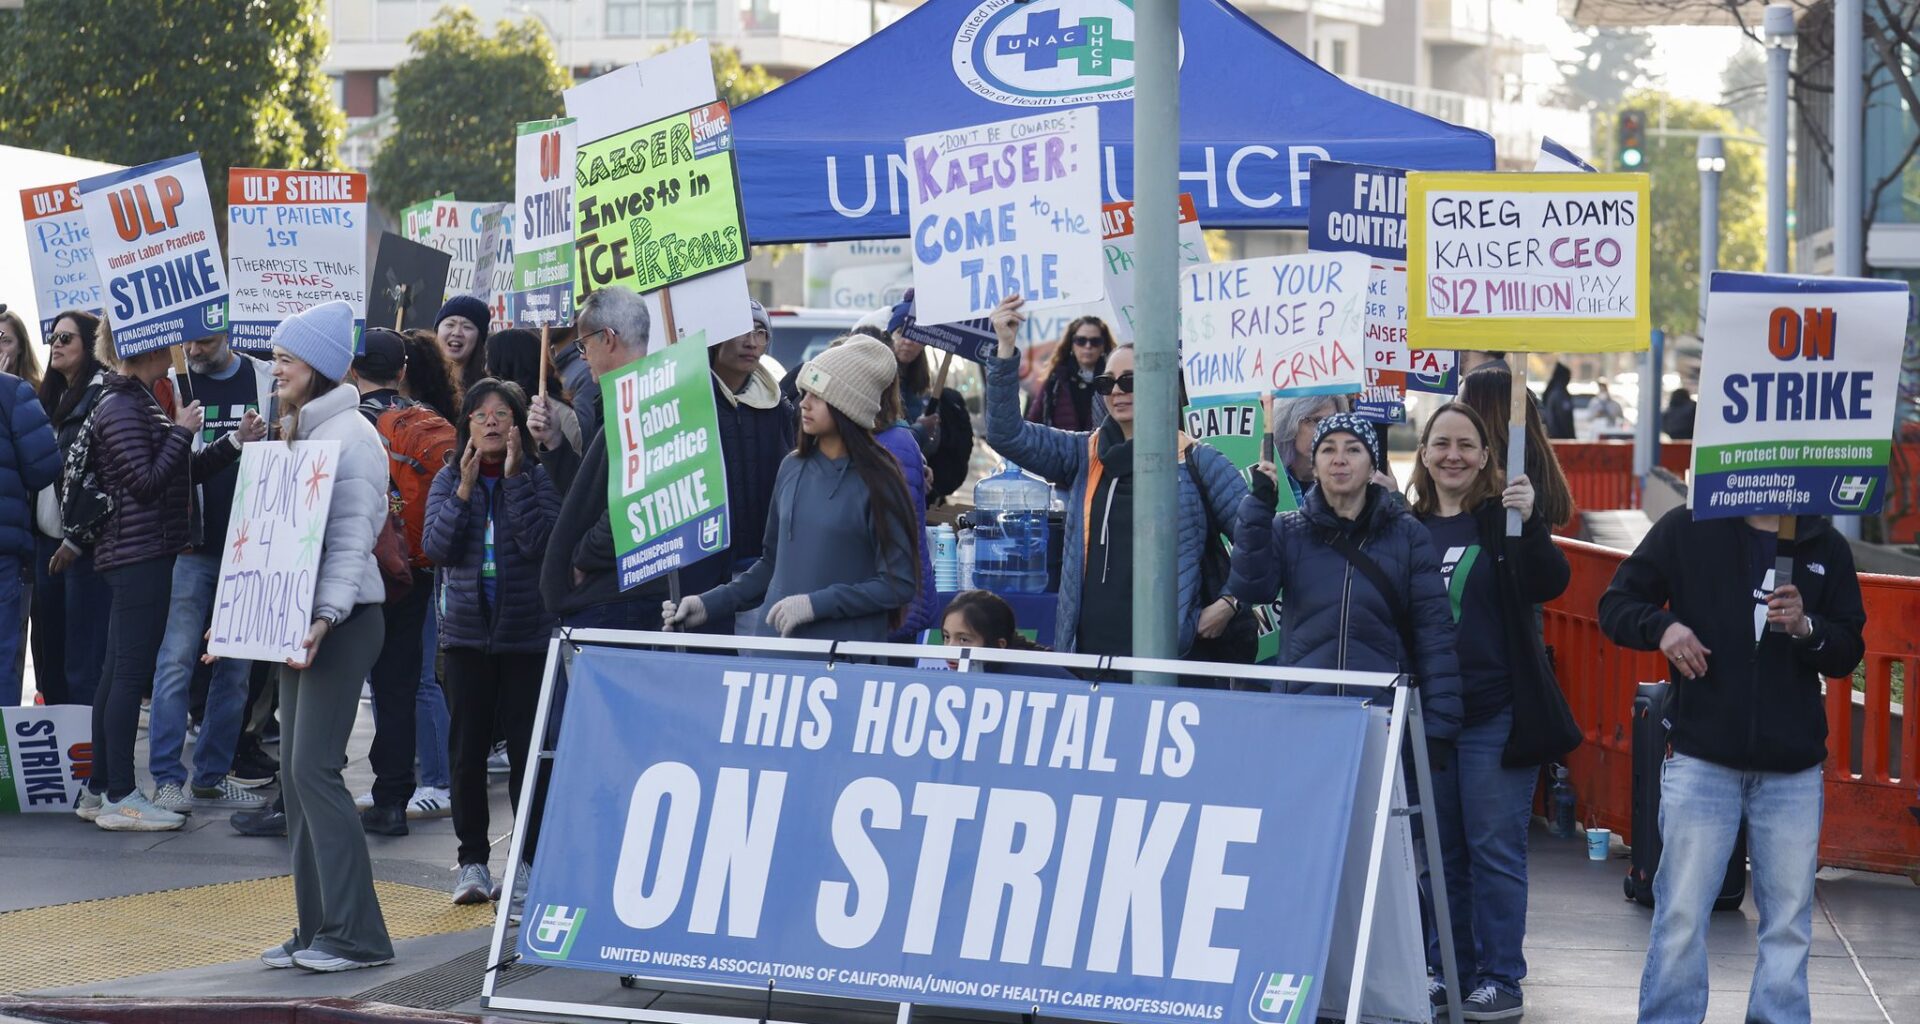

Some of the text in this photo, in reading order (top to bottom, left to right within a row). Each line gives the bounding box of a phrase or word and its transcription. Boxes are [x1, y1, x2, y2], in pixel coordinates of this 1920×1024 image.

[958, 9, 988, 43] United
[1008, 31, 1075, 50] UNAC
[1091, 25, 1103, 69] UHCP
[967, 78, 995, 98] Union
[996, 93, 1013, 105] of
[1012, 96, 1057, 106] Health
[1061, 95, 1094, 104] Care
[691, 108, 709, 128] ULP
[694, 116, 728, 143] STRIKE
[946, 117, 1067, 150] DON'T BE COWARDS
[540, 131, 561, 183] ON
[575, 123, 692, 188] KAISER
[913, 137, 1077, 204] KAISER:
[33, 190, 65, 216] ULP
[243, 176, 352, 201] ULP STRIKE
[578, 170, 710, 234] Invests in
[107, 175, 184, 242] ULP
[230, 206, 353, 228] PUT PATIENTS
[436, 206, 459, 228] PA
[524, 186, 571, 241] STRIKE
[1432, 197, 1635, 229] GREG ADAMS
[35, 221, 90, 252] Patie
[267, 228, 298, 247] 1ST
[915, 195, 1090, 265] COME to the
[1328, 211, 1408, 249] CONTRA
[108, 230, 206, 270] Unfair Labor Practice
[575, 217, 738, 306] ICE PRISONS
[850, 241, 901, 255] thrive
[1436, 237, 1622, 269] KAISER CEO
[54, 272, 87, 286] OVER
[232, 257, 359, 276] THERAPISTS THINK
[261, 273, 334, 288] STRIKES
[961, 254, 1058, 312] TABLE
[1192, 261, 1342, 302] LIKE YOUR
[46, 286, 100, 308] PROF
[110, 248, 220, 321] STRIKE
[236, 288, 363, 302] ARE MORE ACCEPTABLE
[835, 288, 875, 308] Get
[1432, 275, 1480, 315] $12
[1485, 279, 1571, 314] MILLION
[1580, 275, 1621, 296] PAY
[239, 302, 269, 313] THAN
[1577, 295, 1632, 313] CHECK
[117, 318, 184, 343] #UNACUHCPstrong
[120, 331, 182, 356] #TogetherWeWin
[1366, 323, 1407, 343] AISER
[1768, 307, 1837, 361] ON
[1187, 340, 1355, 390] THANK A CRNA
[1375, 351, 1396, 365] OF
[1360, 385, 1400, 403] STRIKE
[1366, 369, 1379, 386] LP
[1722, 371, 1874, 424] STRIKE
[627, 427, 708, 489] Practice
[1720, 444, 1873, 465] To Protect Our Professions
[252, 450, 308, 528] HONK
[1710, 488, 1810, 507] #TogetherWeRise
[1727, 474, 1795, 489] @unacuhcp
[627, 468, 711, 545] STRIKE
[259, 519, 275, 568] 4
[622, 536, 684, 571] #UNACUHCPstrong
[623, 552, 681, 586] #TogetherWeWin
[214, 569, 309, 653] EPIDURALS
[720, 671, 1200, 778] THIS HOSPITAL IS
[15, 719, 68, 806] STRIKE
[612, 761, 788, 939] ON
[815, 776, 1262, 985] STRIKE
[600, 946, 1223, 1020] UNITED NURSES ASSOCIATIONS OF CALIFORNIA/UNION OF HEALTH CARE PROFESSIONALS
